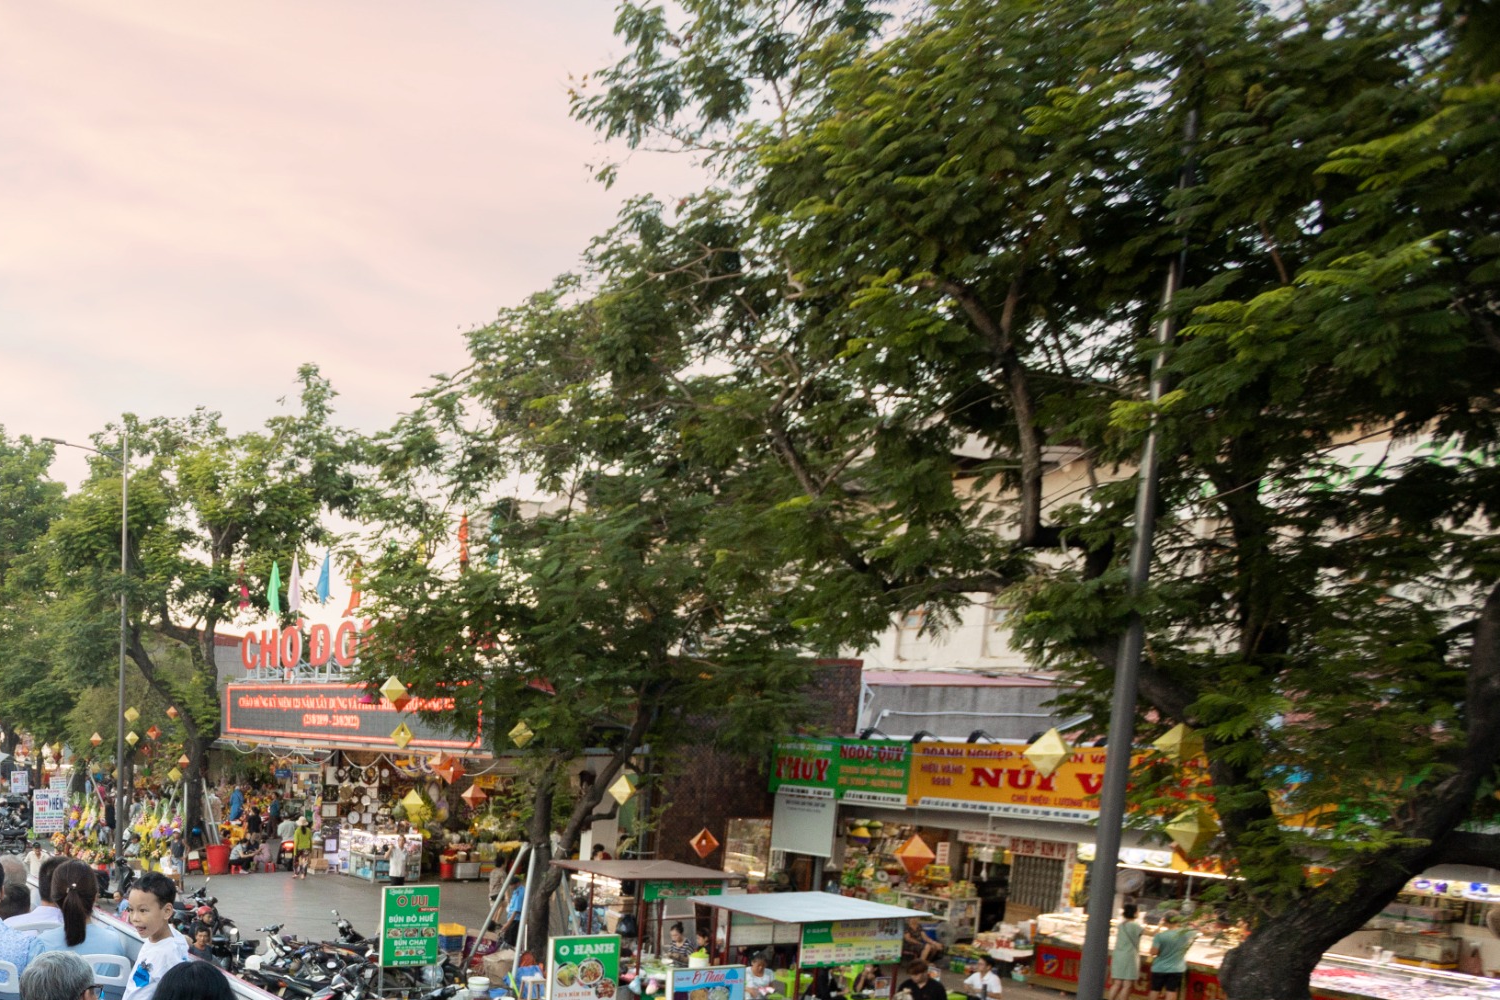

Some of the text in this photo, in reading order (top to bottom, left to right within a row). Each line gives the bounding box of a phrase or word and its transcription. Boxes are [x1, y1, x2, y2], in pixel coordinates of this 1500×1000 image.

[241, 617, 303, 678] CHỢ
[840, 744, 875, 763] NGỌC
[397, 895, 429, 907] O VUI
[389, 912, 435, 923] BÚN BÒ HUẾ
[394, 938, 427, 947] BÚN CHAY
[559, 945, 570, 956] O
[692, 970, 702, 984] O
